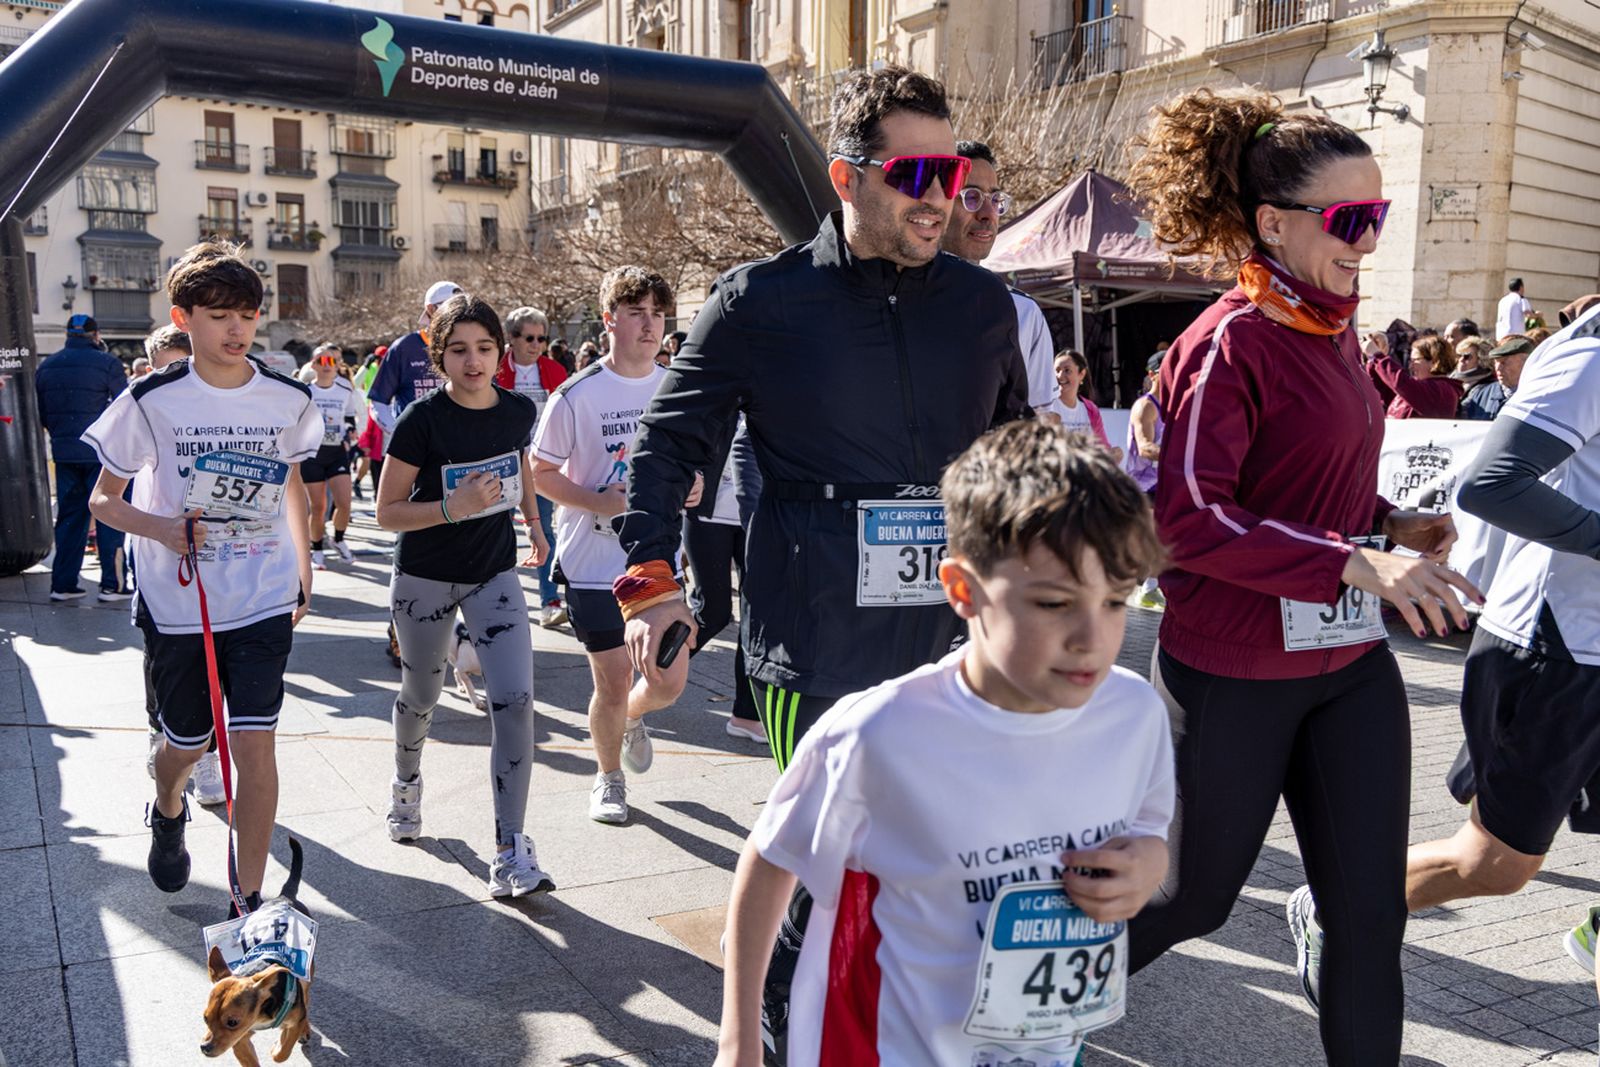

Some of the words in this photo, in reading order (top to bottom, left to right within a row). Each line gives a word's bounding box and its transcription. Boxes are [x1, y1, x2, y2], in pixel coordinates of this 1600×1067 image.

[411, 46, 494, 72] Patronato
[498, 57, 576, 84] Municipal
[579, 69, 600, 85] de
[411, 66, 489, 93] Deportes
[493, 77, 515, 94] de
[518, 80, 558, 100] Jaén
[20, 347, 30, 357] de
[600, 412, 609, 420] VI
[610, 409, 644, 420] CARRERA
[173, 428, 183, 437] VI
[185, 426, 234, 437] CARRERA
[602, 422, 632, 437] BUENA
[176, 441, 213, 456] BUENA
[204, 459, 231, 473] BUENA
[231, 464, 263, 479] MUERTE
[211, 475, 264, 503] 557
[878, 511, 888, 520] VI
[889, 511, 931, 521] CARRERA
[877, 525, 913, 541] BUENA
[916, 525, 949, 541] MUERT
[957, 850, 981, 869] VI
[985, 832, 1078, 865] CARRERA
[1080, 817, 1128, 847] CAMIN
[1018, 897, 1031, 911] VI
[1032, 895, 1074, 911] CARRE
[1011, 919, 1062, 943] BUENA
[1022, 943, 1116, 1007] 439
